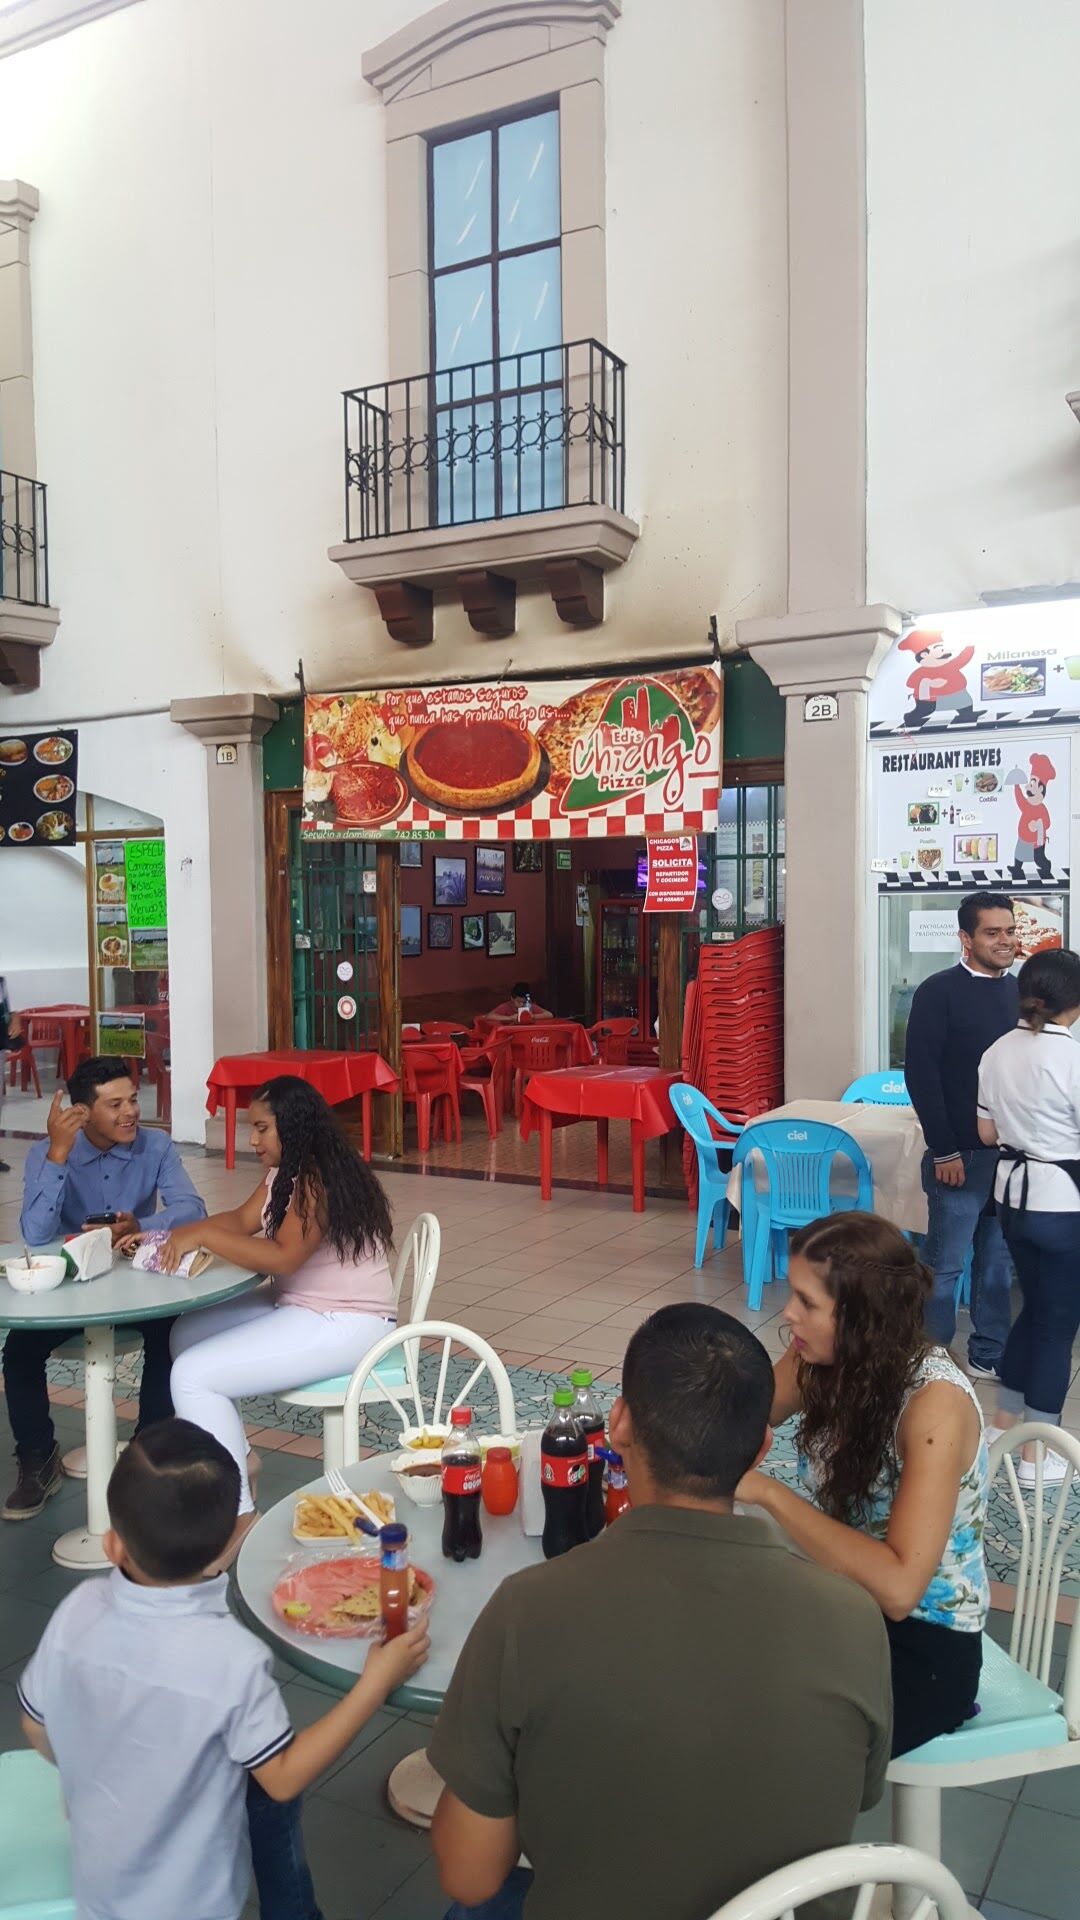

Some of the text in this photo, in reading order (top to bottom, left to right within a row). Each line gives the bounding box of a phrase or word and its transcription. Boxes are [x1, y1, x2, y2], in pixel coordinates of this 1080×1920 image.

[987, 648, 1057, 660] Milanesa
[386, 686, 528, 712] Por que estamos seguros
[811, 704, 832, 717] 2B
[388, 713, 405, 734] que
[409, 712, 436, 724] nunca
[440, 707, 461, 723] has
[465, 706, 504, 728] probado
[508, 703, 537, 731] algo
[221, 751, 233, 761] 1B
[882, 748, 1001, 773] RESTAURANT REYES
[573, 733, 711, 806] Chicago
[600, 774, 644, 790] Pizza
[303, 829, 335, 840] Servicio
[343, 829, 382, 840] domicilio
[395, 831, 410, 840] 742
[411, 831, 422, 840] 85
[425, 831, 435, 840] 30
[652, 858, 693, 867] SOLICITA
[787, 1129, 807, 1141] ciel
